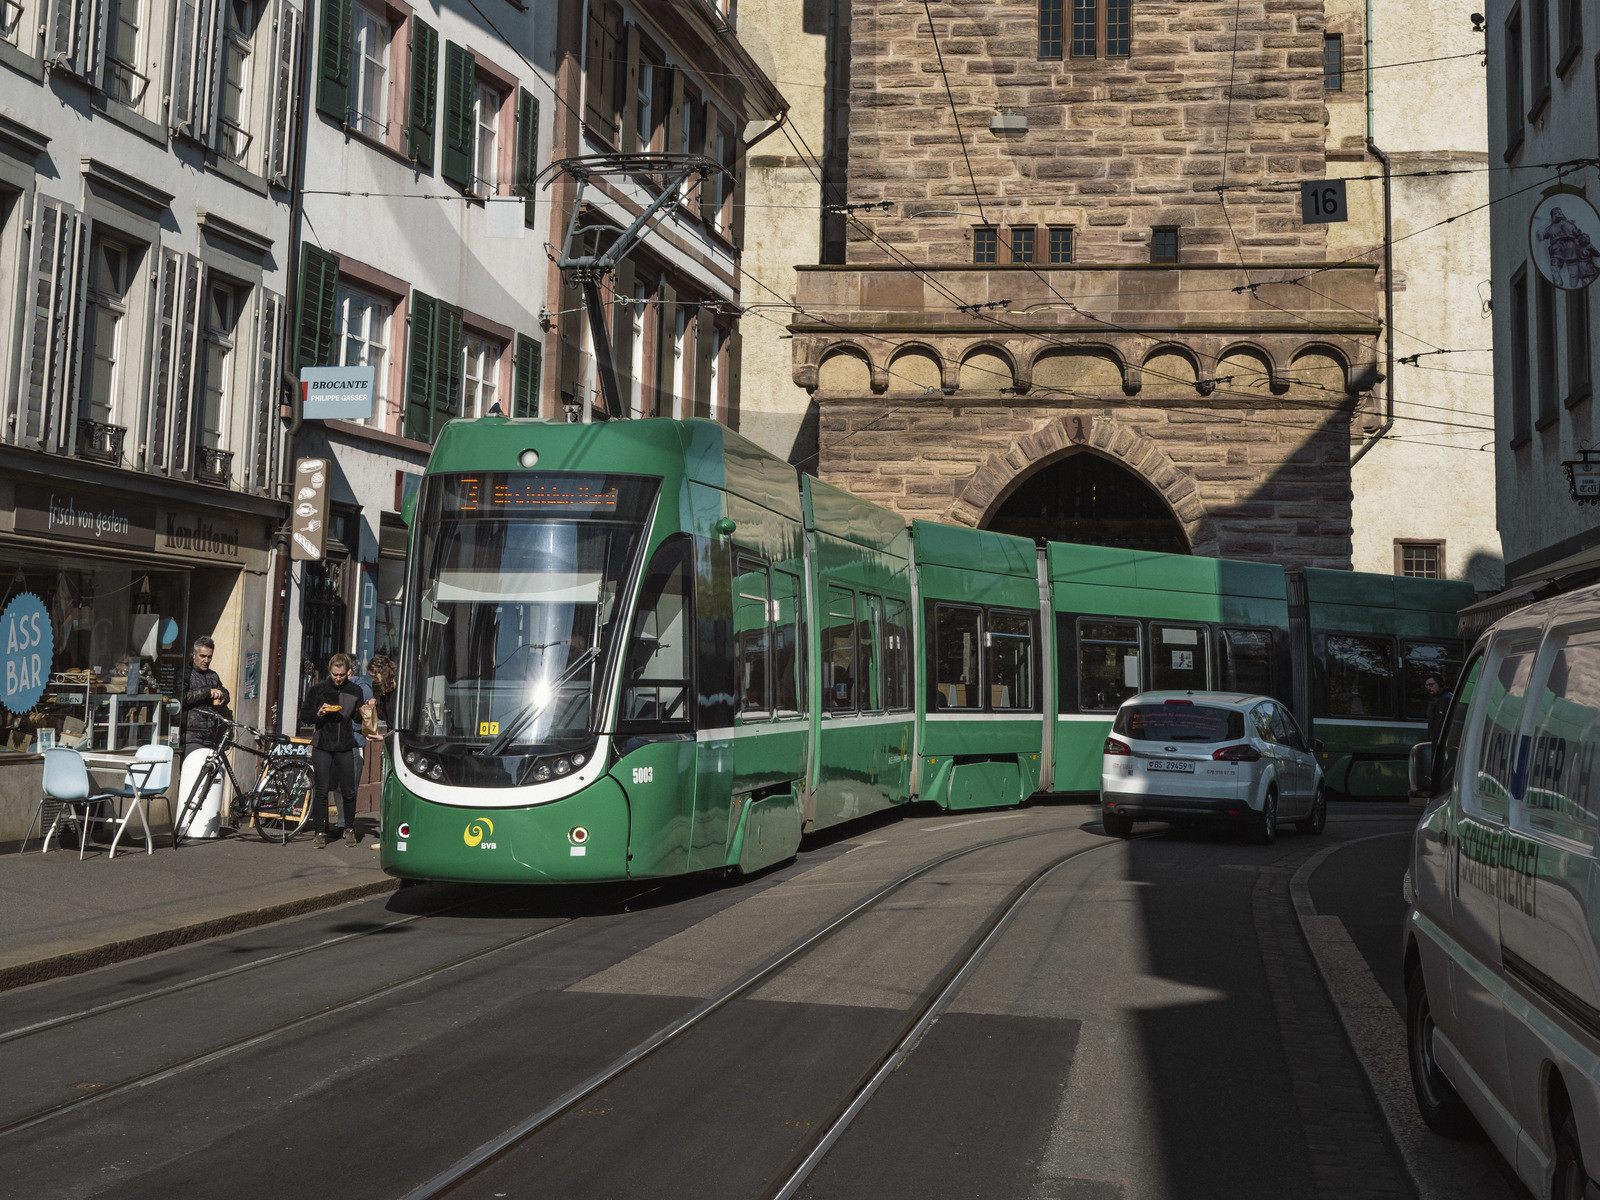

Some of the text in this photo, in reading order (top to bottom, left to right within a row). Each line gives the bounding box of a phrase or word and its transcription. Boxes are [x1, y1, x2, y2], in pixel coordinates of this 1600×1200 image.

[1310, 188, 1338, 216] 16
[312, 381, 368, 389] BROCANTE
[341, 394, 368, 402] GASSER
[1580, 485, 1597, 493] Tell
[48, 493, 129, 537] frisch von gestern
[164, 512, 240, 557] Konditorei
[6, 611, 42, 655] ÄSS
[6, 654, 42, 697] BAR
[632, 766, 654, 785] 5003
[1154, 760, 1188, 771] BS 29459
[481, 842, 497, 850] BVB
[1463, 822, 1539, 919] SCHREINEREI
